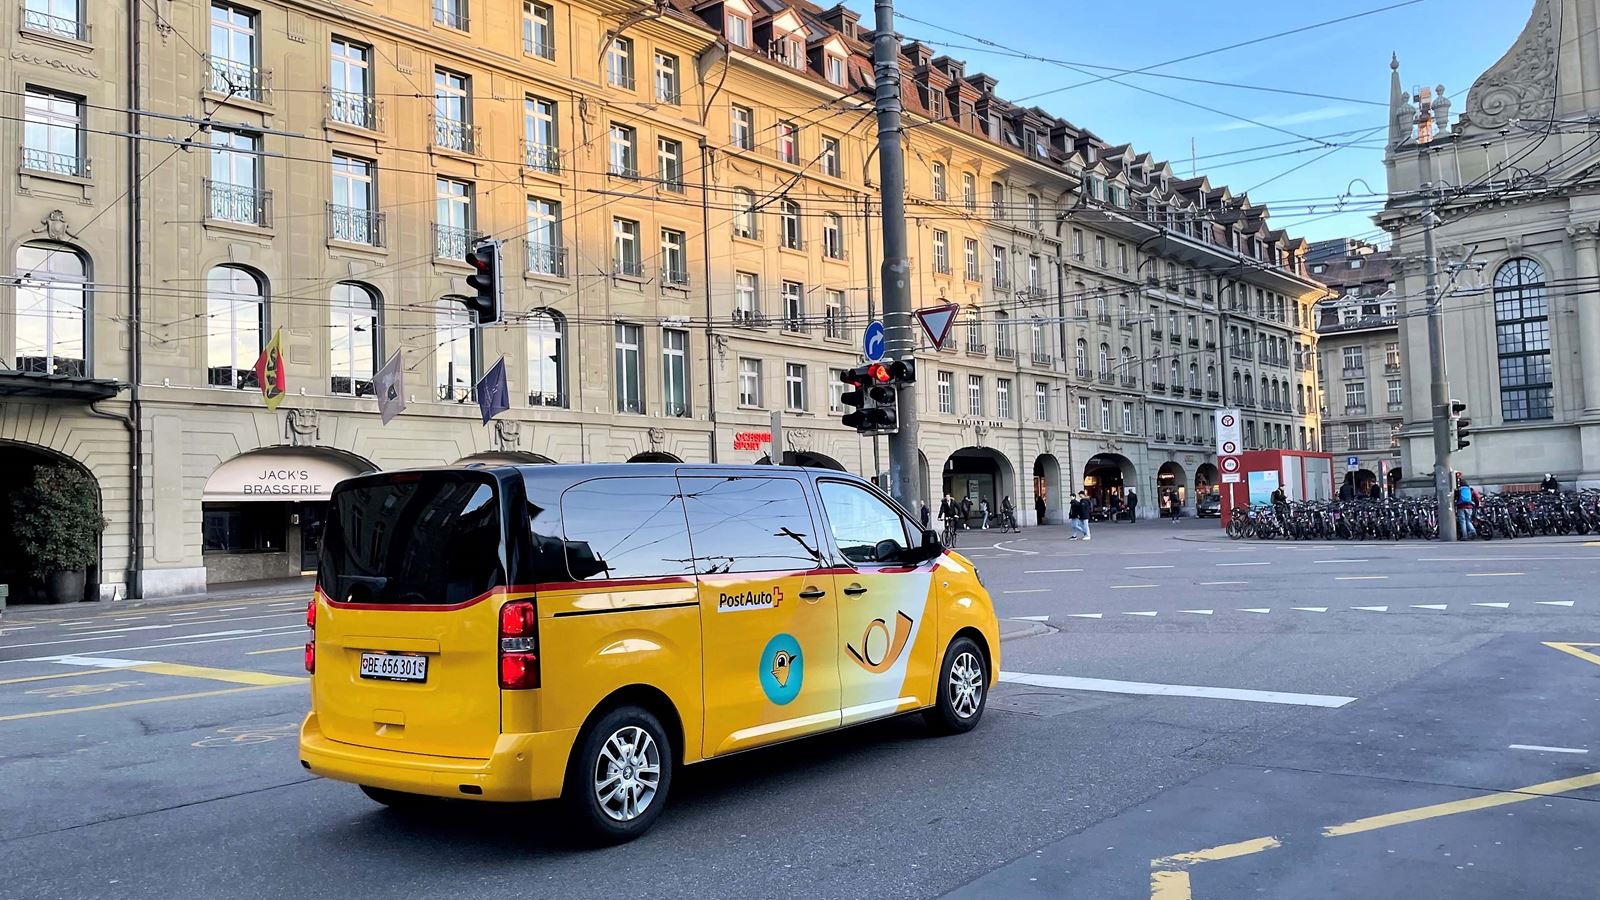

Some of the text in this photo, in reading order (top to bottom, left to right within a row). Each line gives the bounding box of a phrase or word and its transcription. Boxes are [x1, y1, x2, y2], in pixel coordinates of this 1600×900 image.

[735, 432, 772, 442] OCHSNE
[734, 441, 760, 450] SPORT
[259, 470, 308, 480] JACK'S
[243, 485, 321, 494] BRASSERIE
[719, 591, 772, 608] PostAuto
